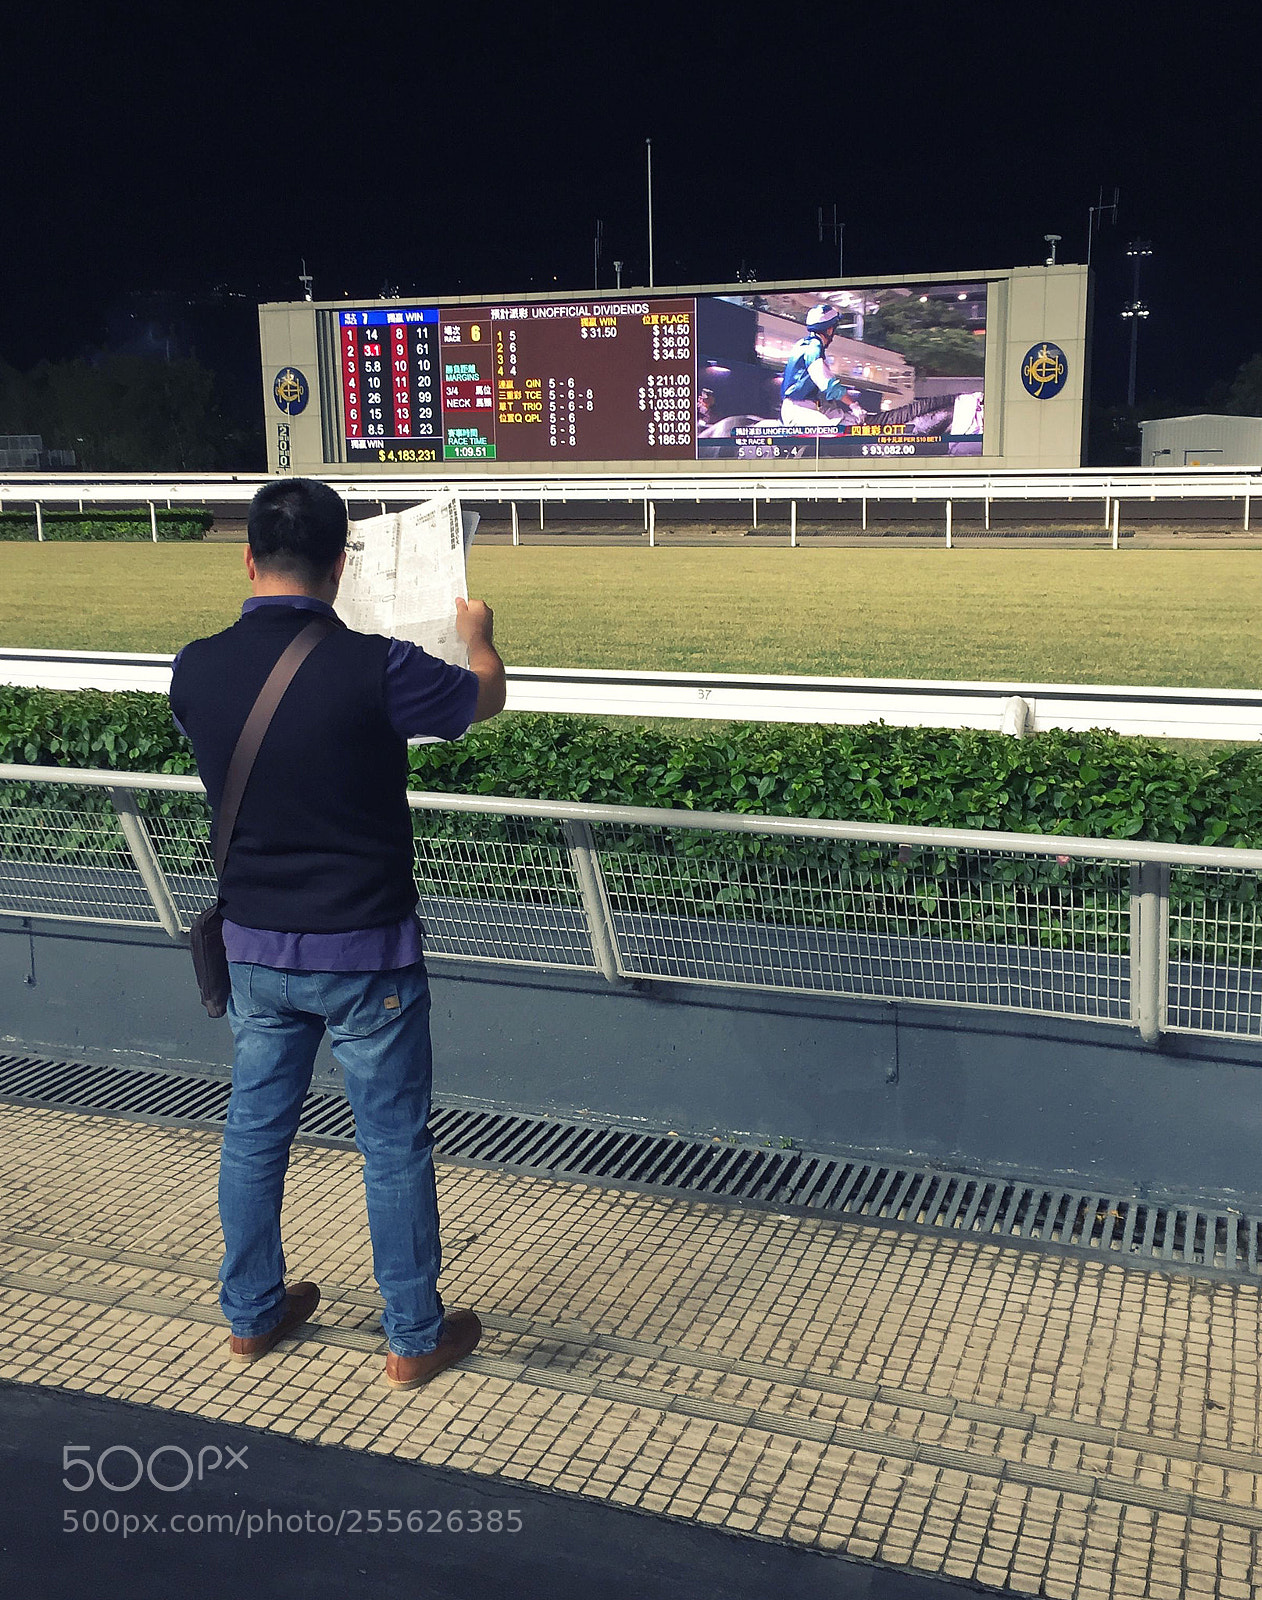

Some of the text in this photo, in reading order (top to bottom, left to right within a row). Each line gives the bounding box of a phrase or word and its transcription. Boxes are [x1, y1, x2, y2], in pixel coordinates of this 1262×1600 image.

[532, 307, 591, 318] UNOFFICIAL
[593, 304, 649, 315] DIVIDENDS
[405, 312, 423, 321] WIN
[599, 317, 616, 325] WIN
[660, 314, 689, 323] PLACE
[347, 327, 428, 341] 1 14 8 11
[471, 325, 480, 341] 6
[497, 331, 516, 341] 1 5
[347, 344, 428, 357] 2 3.1 9 61
[497, 342, 516, 353] 2 6
[497, 354, 516, 364] 3 8
[348, 360, 430, 373] 3 5.8 10 10
[498, 366, 517, 376] 4 4
[349, 376, 431, 388] 4 10 11 20
[526, 379, 541, 388] QIN
[549, 378, 555, 388] 5
[567, 378, 574, 387] 6
[446, 387, 458, 395] 3/4
[525, 391, 541, 399] TCE
[549, 390, 555, 400] 5
[568, 390, 575, 399] 6
[586, 389, 593, 399] 8
[350, 392, 432, 404] 5 26 12 99
[447, 399, 471, 407] NECK
[549, 402, 556, 411] 5
[568, 401, 575, 411] 6
[586, 401, 593, 411] 8
[350, 408, 432, 420] 6 15 13 29
[525, 414, 542, 422] QPL
[549, 414, 556, 423] 5
[568, 413, 575, 423] 6
[351, 423, 433, 435] 7 8.5 14 23
[550, 425, 556, 435] 5
[568, 425, 575, 434] 8
[763, 427, 803, 435] UNOFFICIAL
[883, 425, 906, 435] QTT
[368, 440, 384, 448] WIN
[550, 437, 557, 446] 6
[569, 436, 576, 446] 8
[388, 450, 435, 462] 4,183,231
[455, 447, 486, 456] 1:09.51
